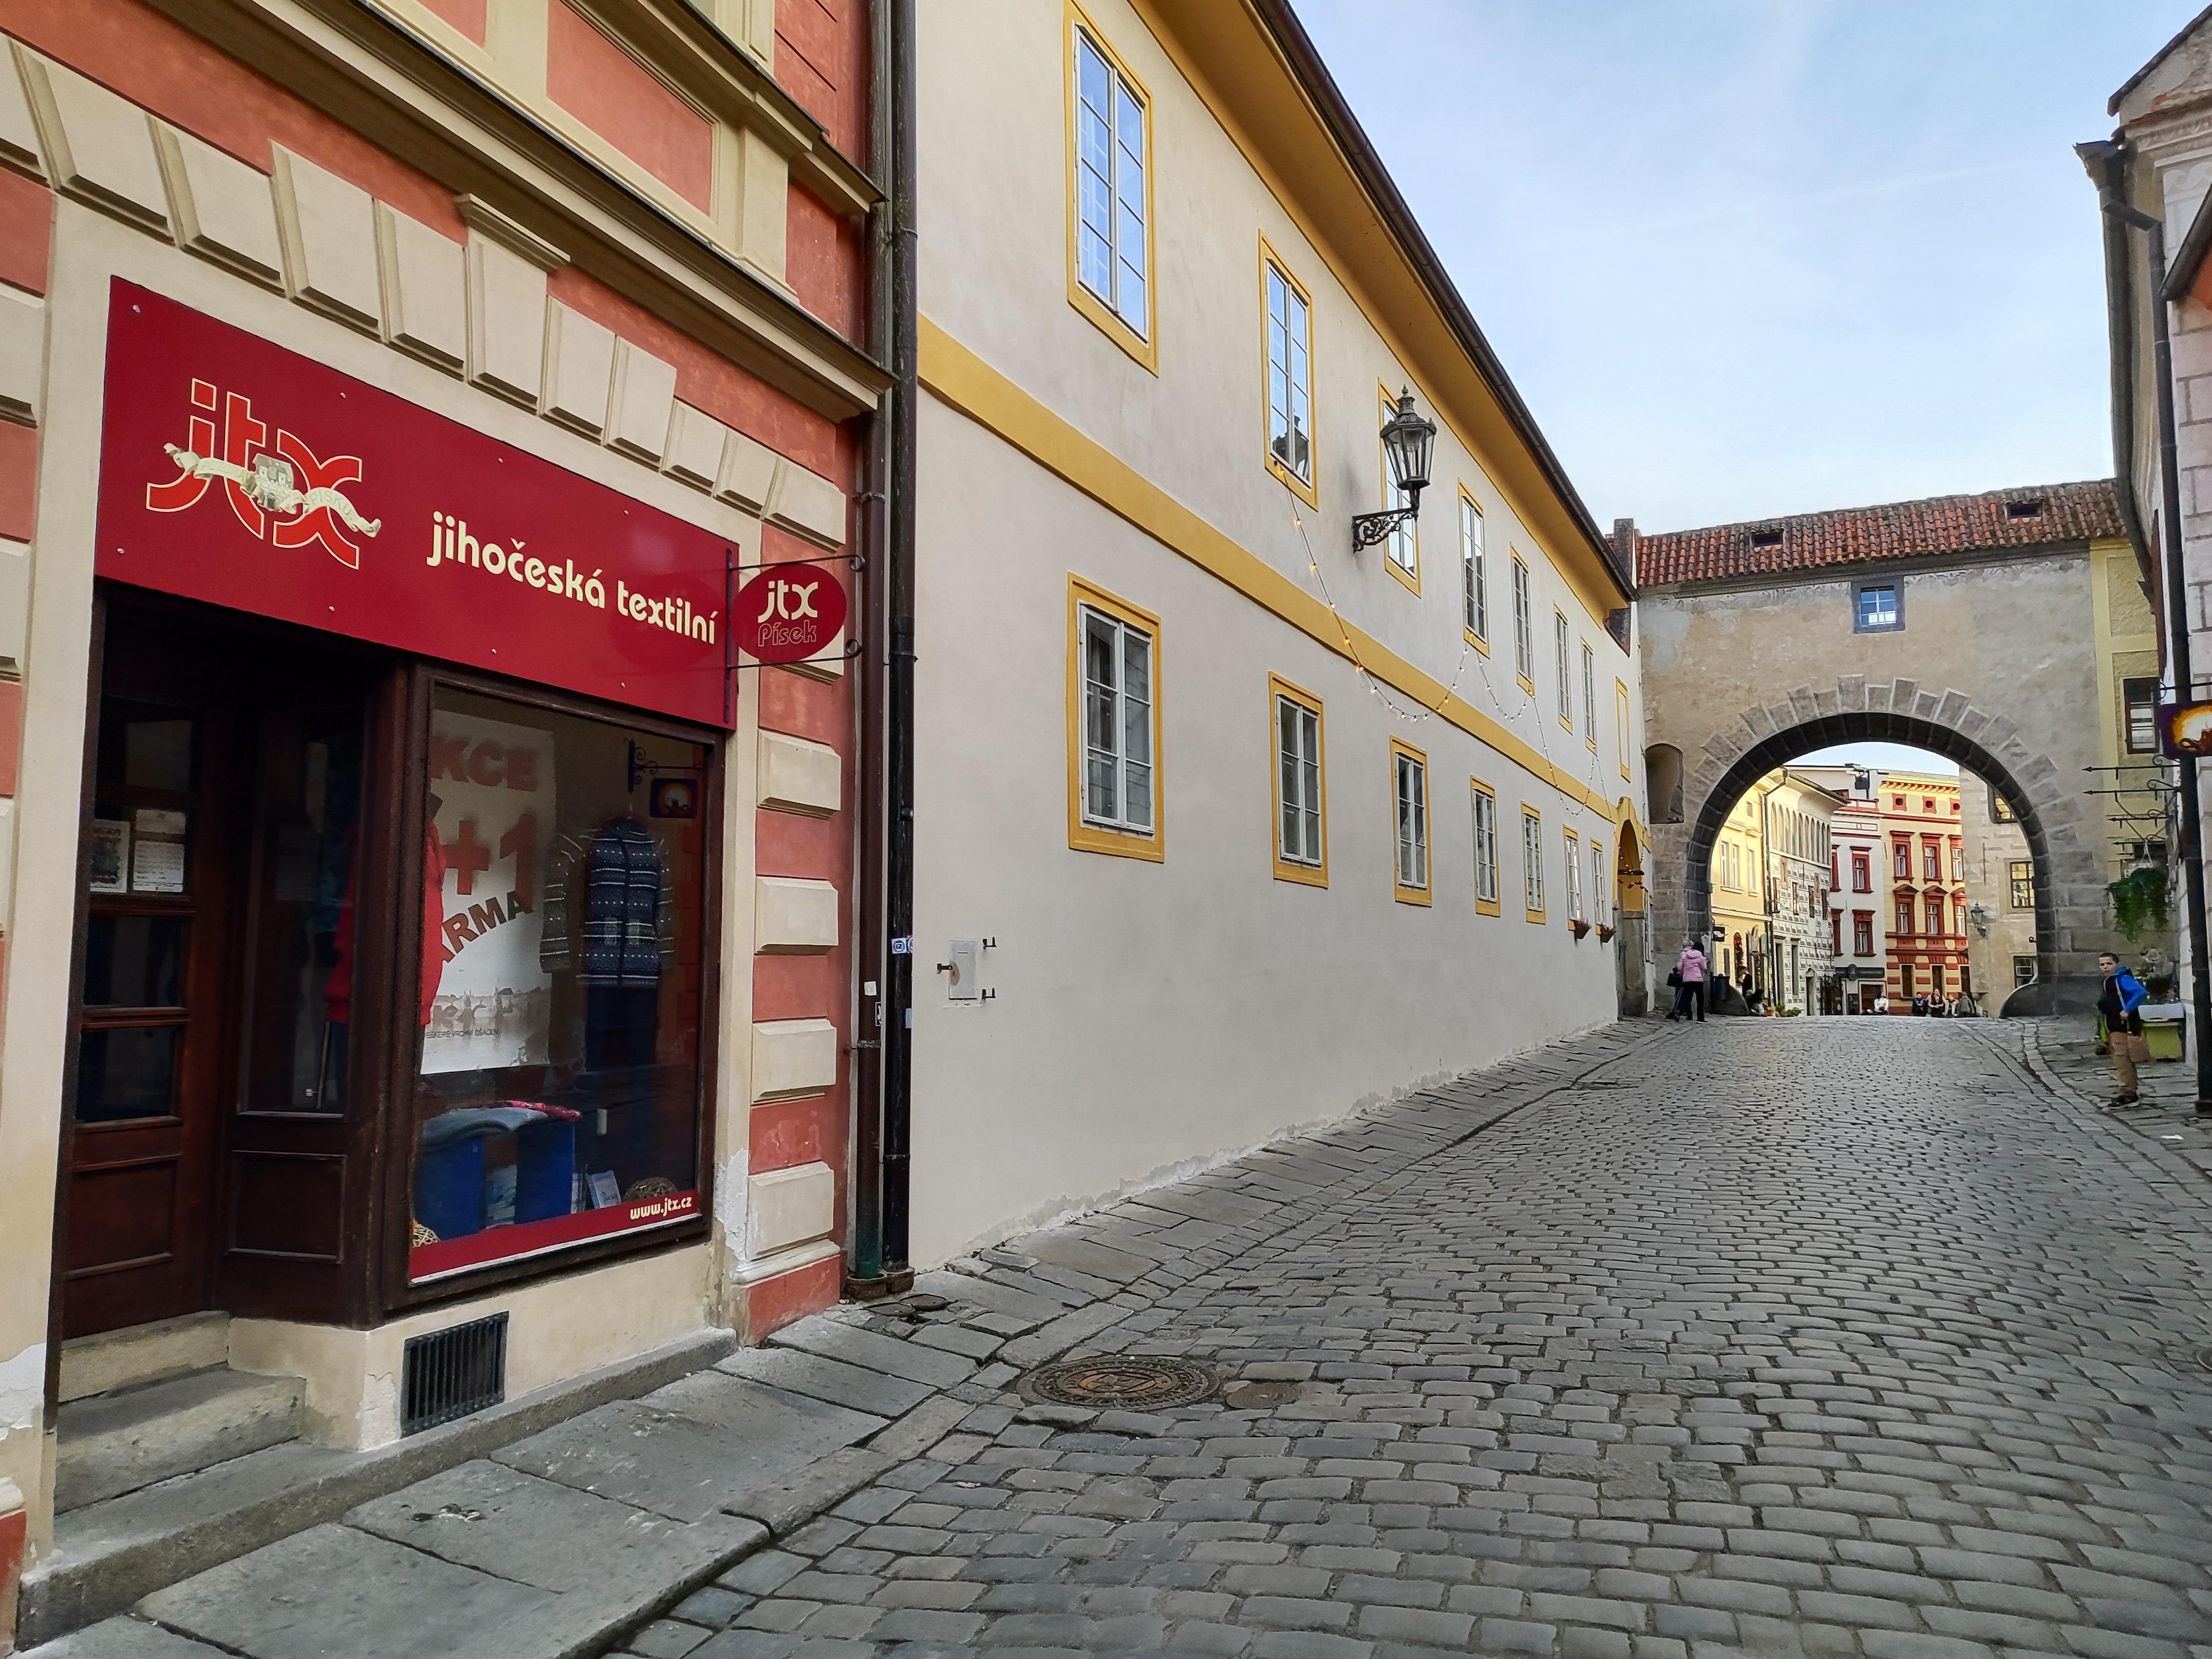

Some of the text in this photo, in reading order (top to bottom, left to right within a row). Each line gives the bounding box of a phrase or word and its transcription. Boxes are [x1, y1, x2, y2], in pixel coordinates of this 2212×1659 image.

[146, 378, 362, 570] jtx
[426, 511, 718, 644] jihočeská textilní
[758, 580, 818, 623] jtx
[758, 620, 817, 646] Písek
[630, 1197, 692, 1220] www.jtx.cz
